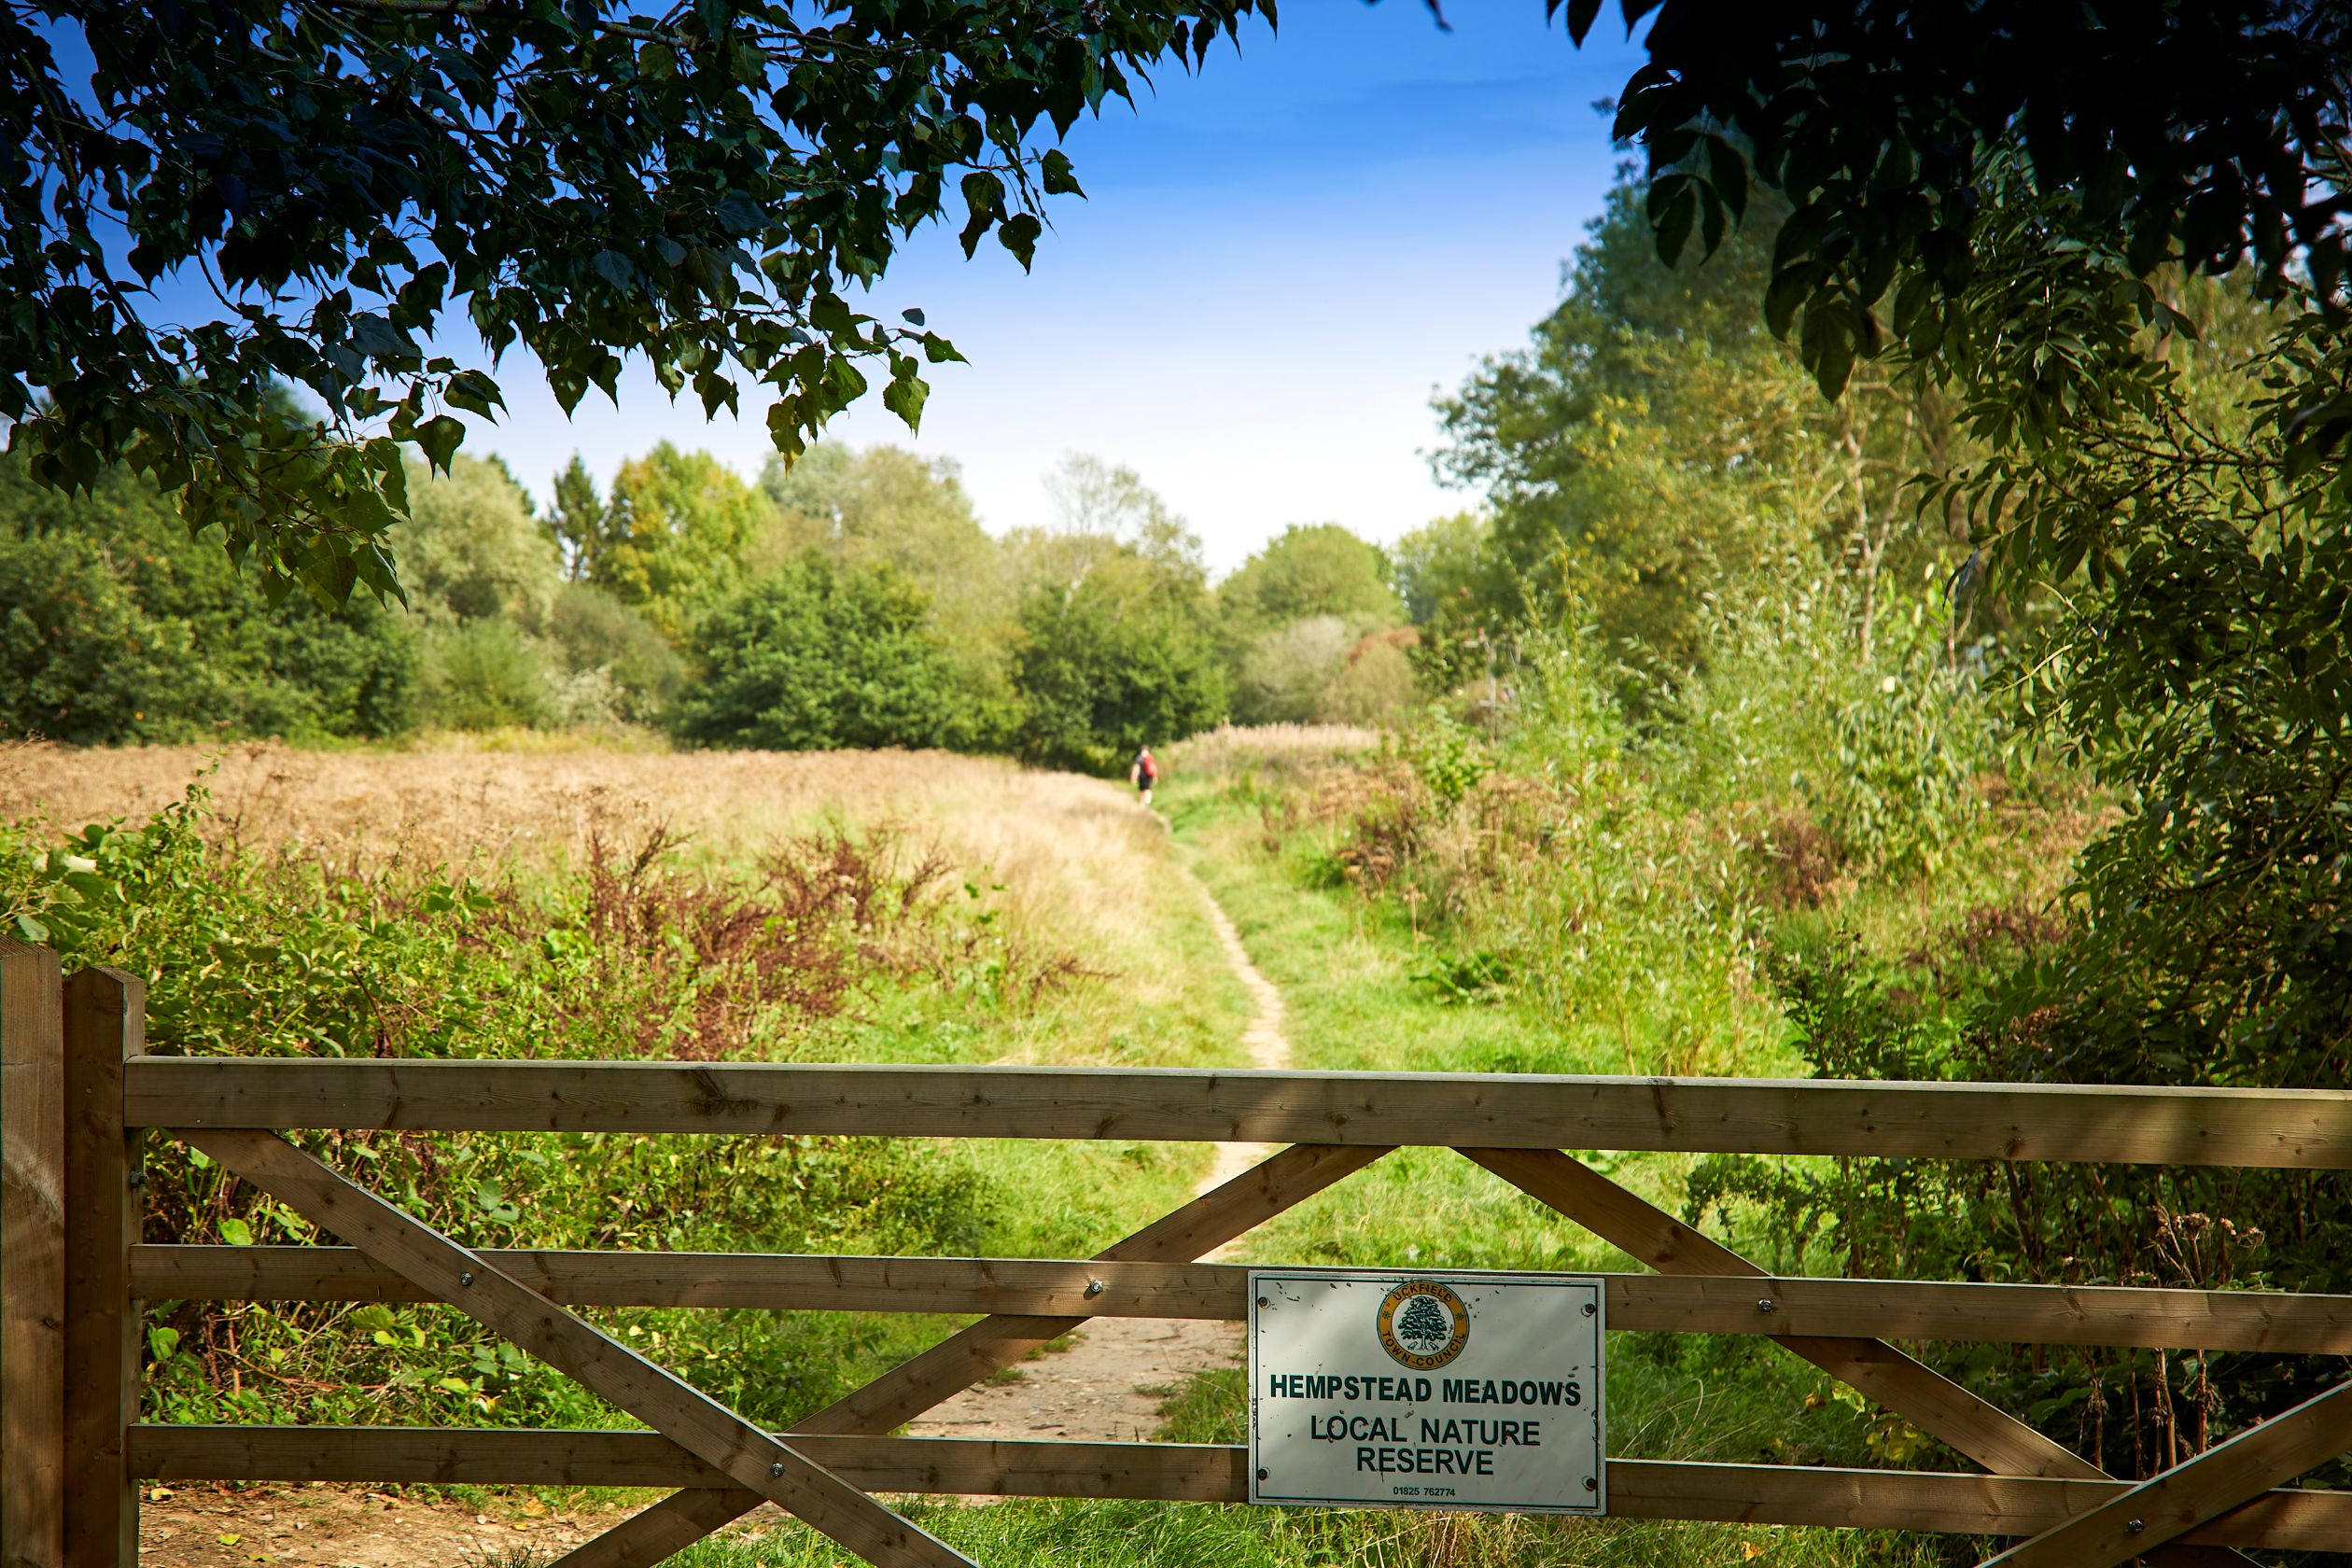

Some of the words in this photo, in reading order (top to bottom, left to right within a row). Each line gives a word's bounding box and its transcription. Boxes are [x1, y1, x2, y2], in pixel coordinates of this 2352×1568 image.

[1393, 1283, 1452, 1302] UCKFIELD
[1382, 1331, 1410, 1363] TOWN
[1416, 1333, 1465, 1366] COUNCIL
[1270, 1374, 1432, 1402] HEMPSTEAD
[1443, 1379, 1581, 1407] MEADOWS
[1311, 1415, 1407, 1442] LOCAL
[1421, 1419, 1540, 1446] NATURE
[1357, 1448, 1493, 1476] RESERVE
[1393, 1486, 1420, 1496] 01825
[1423, 1487, 1456, 1497] 762774
